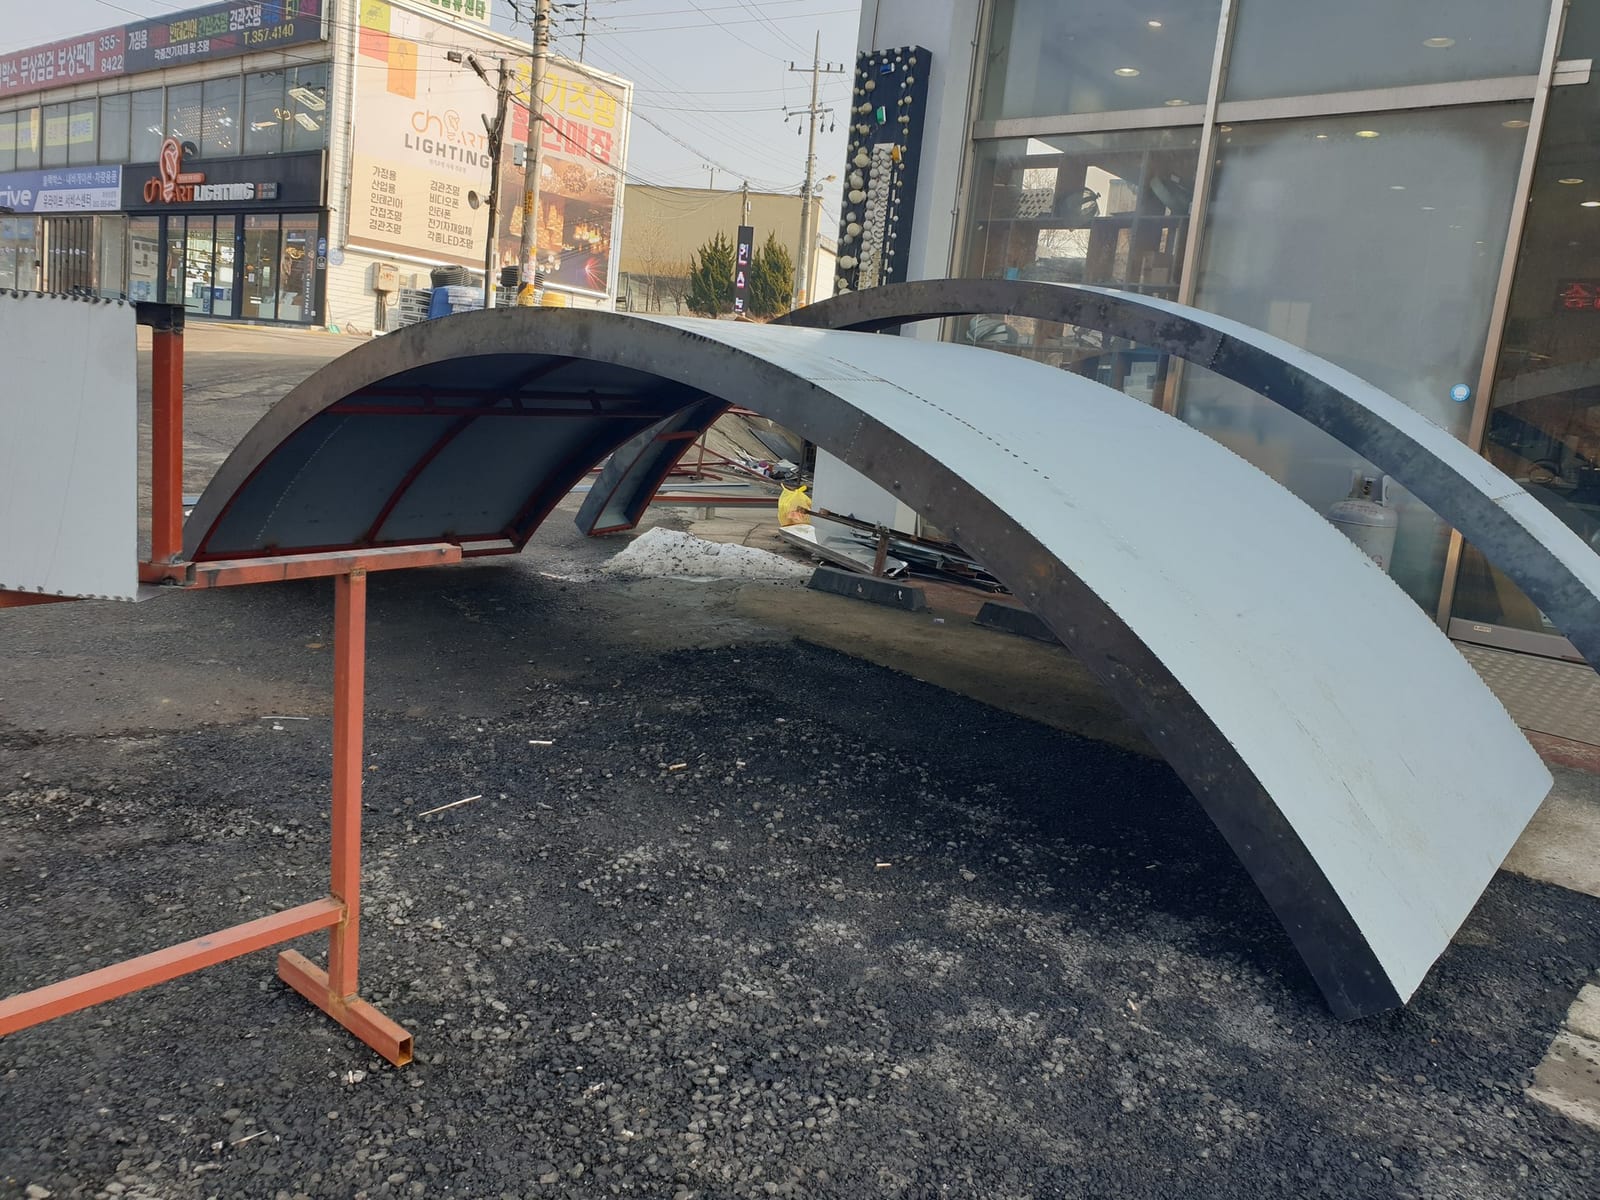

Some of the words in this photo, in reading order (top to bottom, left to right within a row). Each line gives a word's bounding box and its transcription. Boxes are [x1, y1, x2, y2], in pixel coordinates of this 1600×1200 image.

[128, 29, 148, 51] 가정용
[20, 50, 55, 85] 무상점검
[57, 40, 96, 77] 보상판매
[101, 54, 123, 73] 8422
[404, 132, 490, 169] LIGHTING
[372, 165, 397, 181] 가정용
[193, 182, 255, 202] LIGHTING
[371, 179, 396, 195] 산업용
[370, 192, 403, 209] 인테리어
[429, 192, 459, 209] 비디오폰
[369, 205, 402, 222] 간접조명
[428, 205, 451, 220] 인터폰
[369, 218, 402, 235] 경관조명
